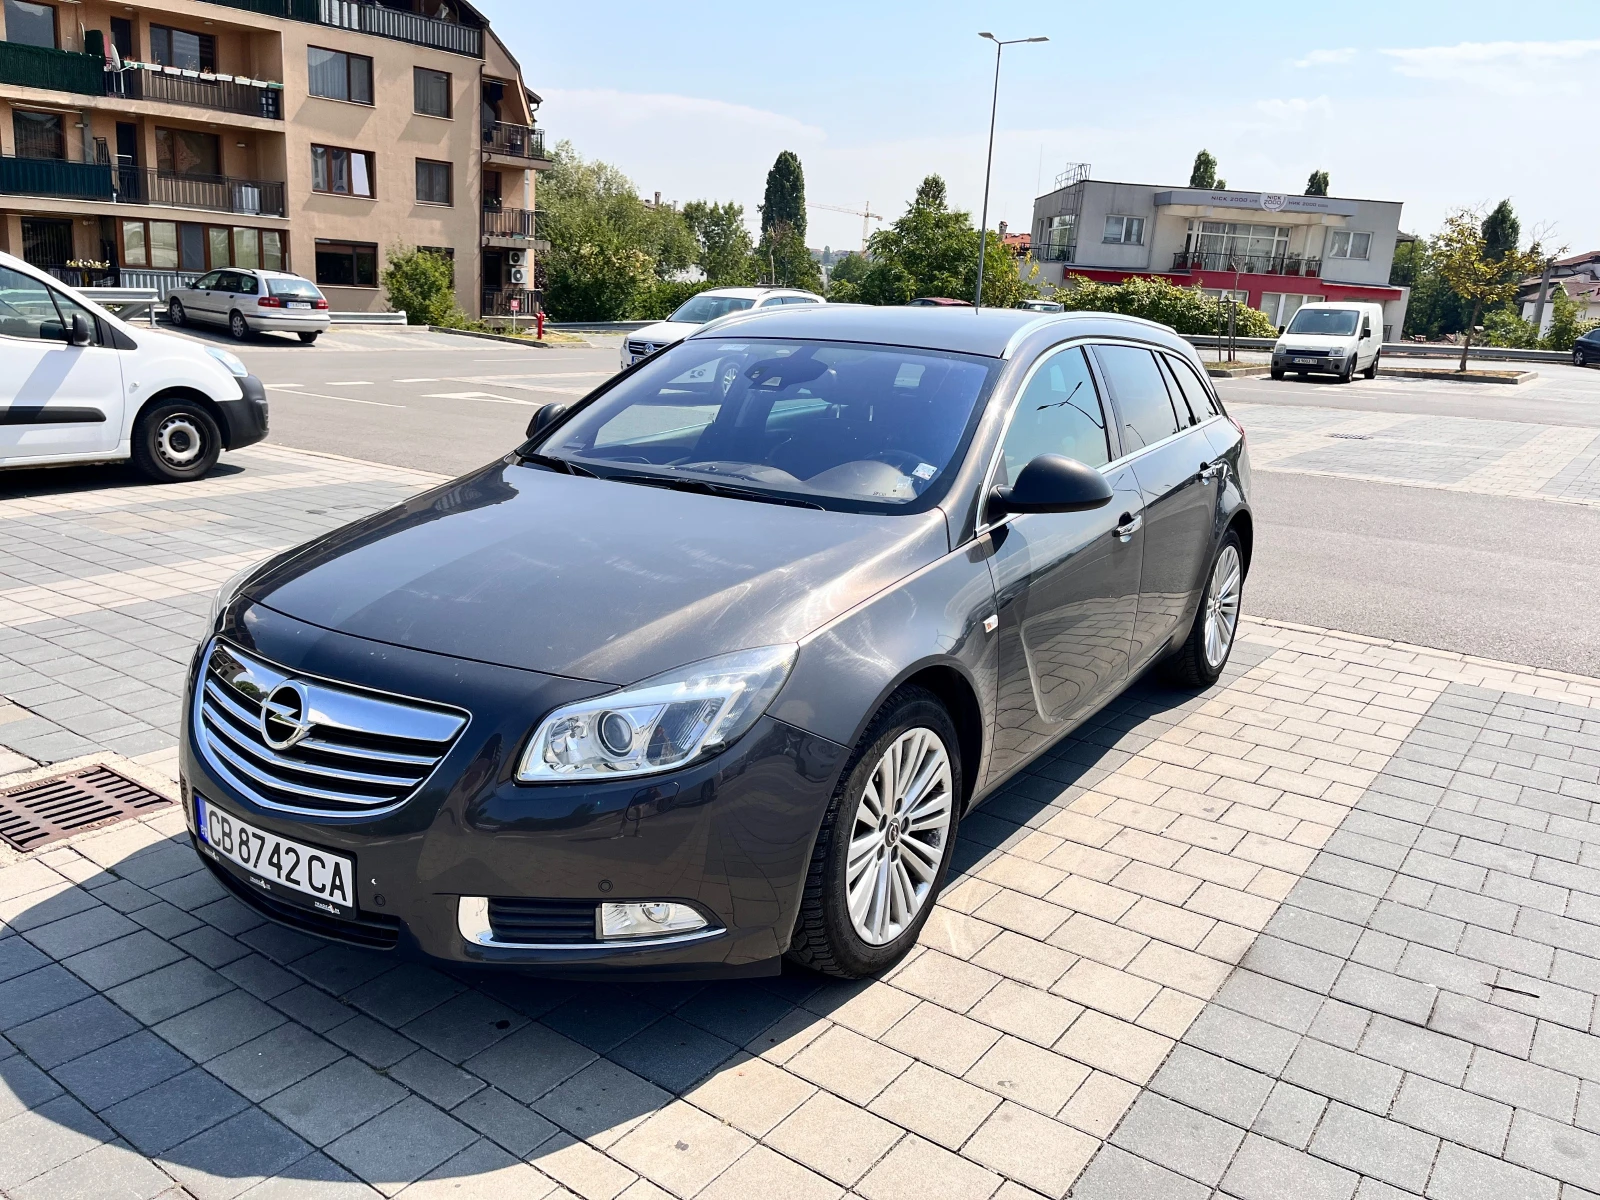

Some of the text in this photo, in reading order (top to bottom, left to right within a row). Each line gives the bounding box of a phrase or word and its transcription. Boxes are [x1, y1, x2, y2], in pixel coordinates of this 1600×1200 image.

[208, 809, 348, 903] CB 8742 CA
